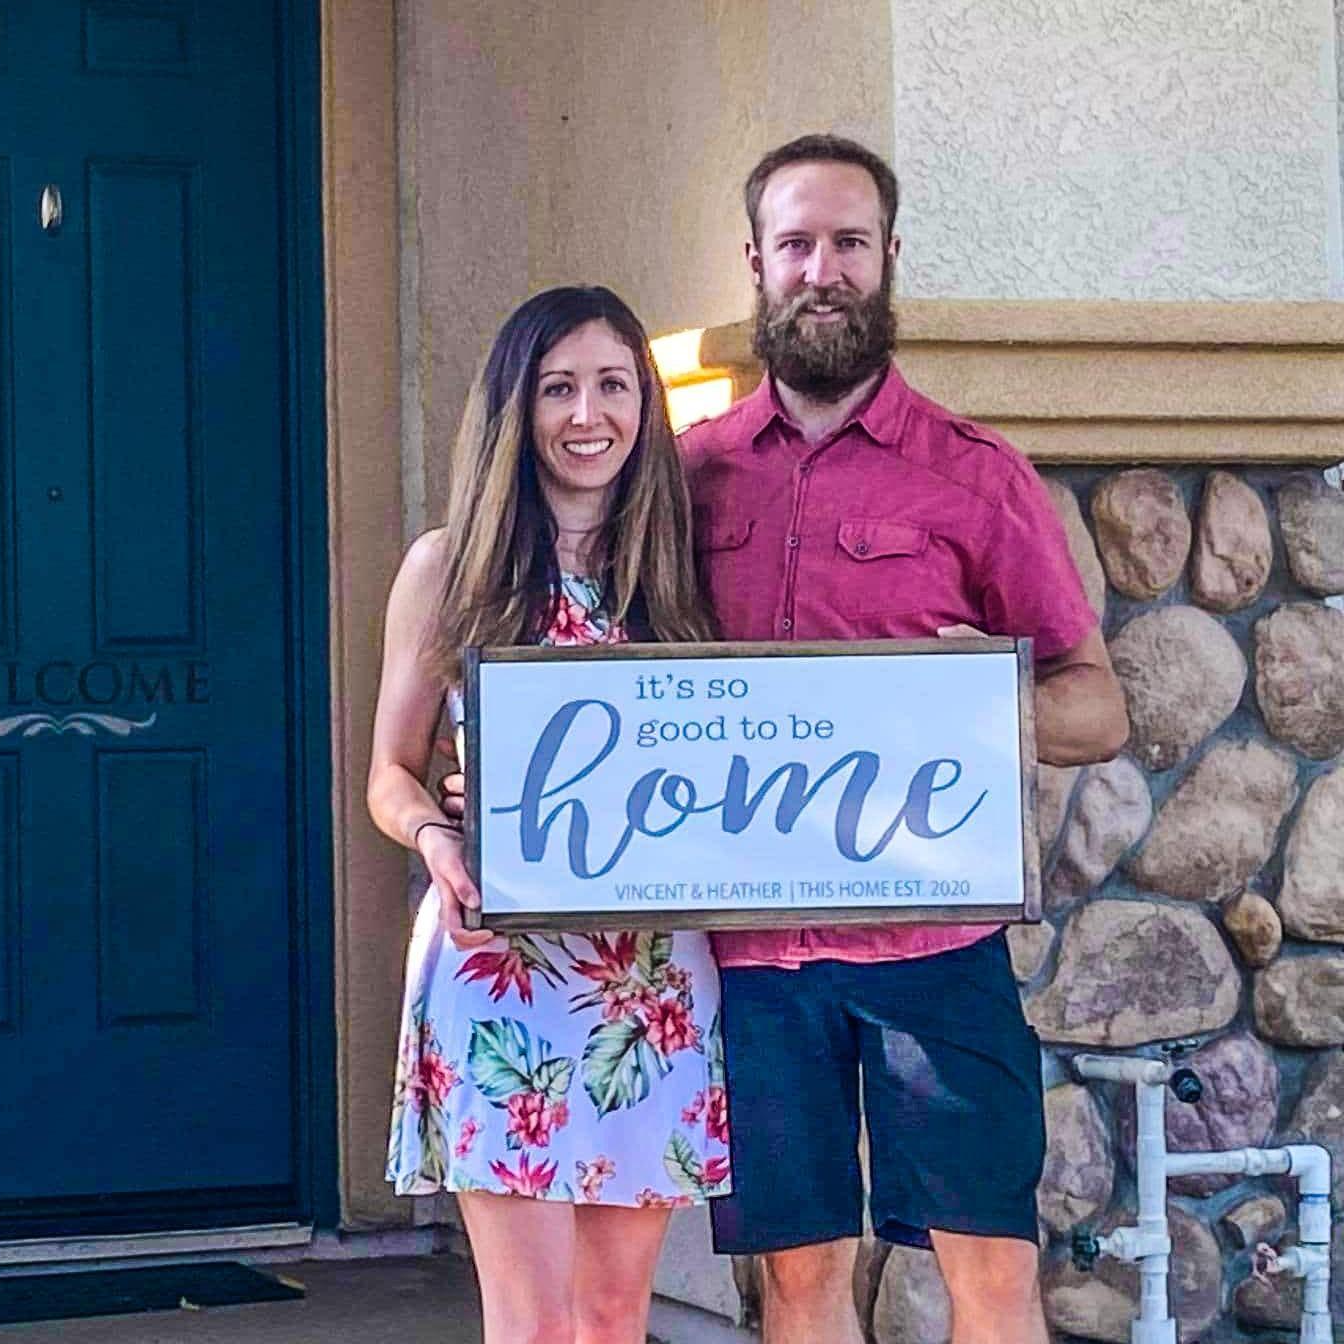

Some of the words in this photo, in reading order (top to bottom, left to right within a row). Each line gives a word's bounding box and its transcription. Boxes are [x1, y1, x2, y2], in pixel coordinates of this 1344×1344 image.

[635, 673, 694, 700] it's
[707, 678, 749, 699] so
[636, 715, 728, 748] good
[739, 715, 778, 740] to
[787, 714, 834, 740] be
[490, 698, 988, 879] home
[615, 882, 688, 901] VINCENT
[691, 883, 702, 900] &
[707, 882, 782, 900] HEATHER
[799, 881, 834, 898] THIS
[839, 881, 889, 898] HOME
[931, 880, 971, 897] 2020
